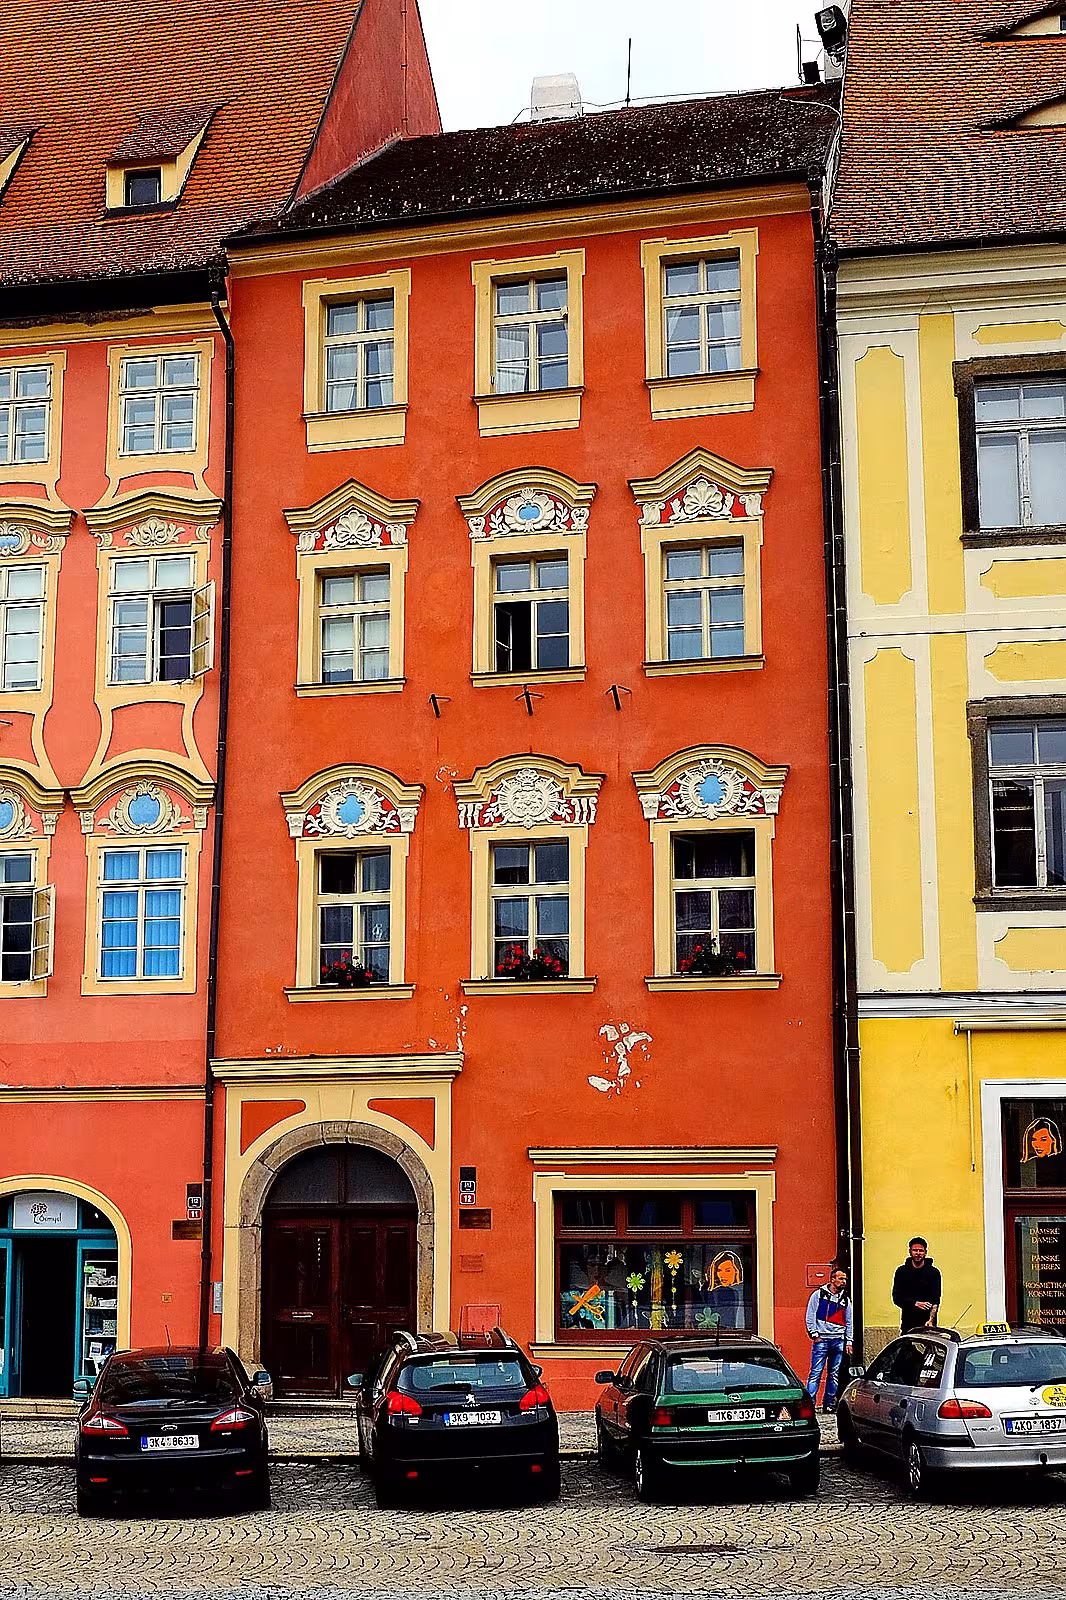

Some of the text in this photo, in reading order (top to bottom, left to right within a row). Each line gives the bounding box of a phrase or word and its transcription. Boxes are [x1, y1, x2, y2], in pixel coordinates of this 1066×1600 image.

[1031, 1236, 1059, 1244] DAMEN
[1031, 1263, 1061, 1271] HERREN
[1028, 1290, 1065, 1298] KOSMETIK
[983, 1325, 1007, 1333] TAXI
[451, 1412, 497, 1423] 3K9 1032
[715, 1408, 762, 1420] 1K6 3378
[1040, 1419, 1062, 1430] 1837
[149, 1436, 195, 1448] 3K4 8633
